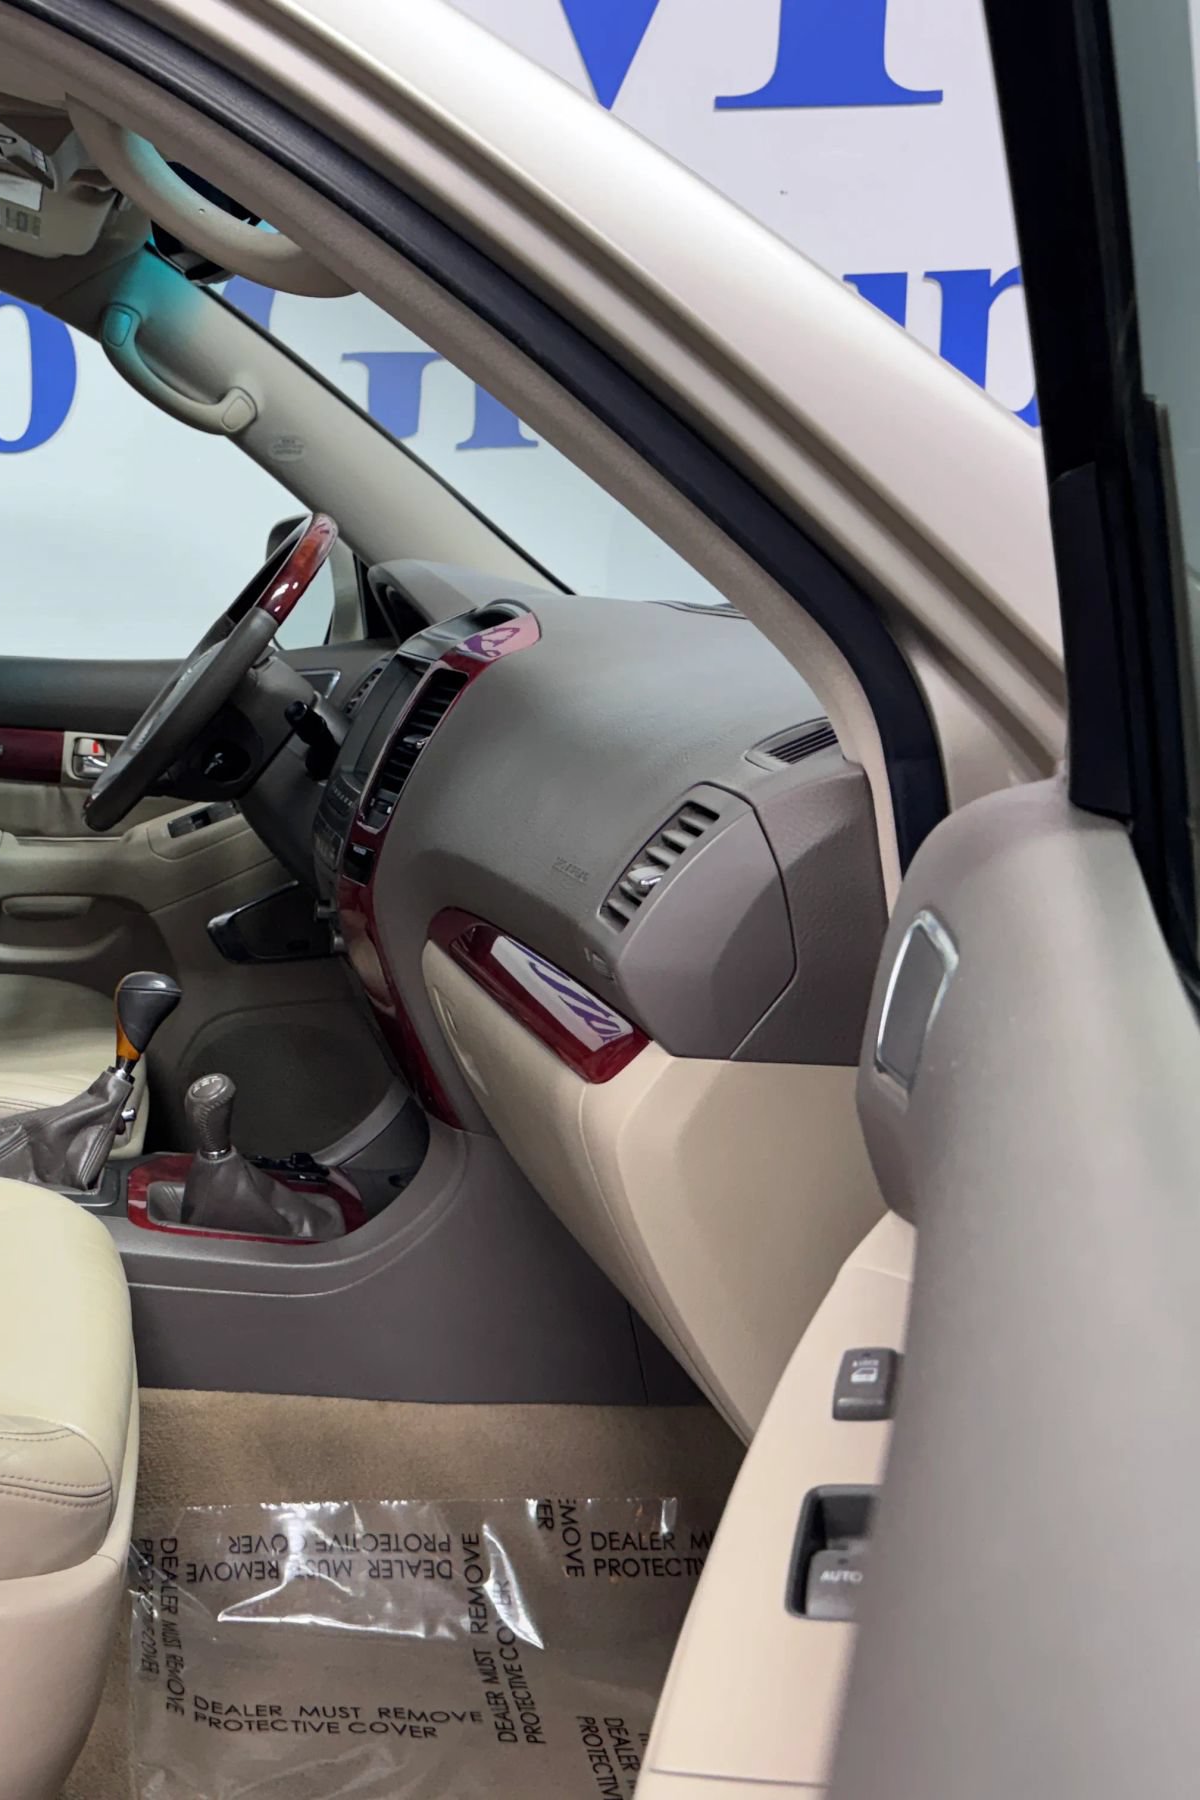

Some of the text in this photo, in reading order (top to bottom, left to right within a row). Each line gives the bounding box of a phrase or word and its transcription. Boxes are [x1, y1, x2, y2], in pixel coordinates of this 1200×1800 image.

[590, 1530, 676, 1551] DEALER
[186, 1560, 279, 1584] REMOVE
[368, 1558, 453, 1579] DEALER
[820, 1570, 863, 1583] AUTO
[160, 1537, 185, 1717] DEALER MUST REMOVE
[462, 1533, 518, 1744] DEALER MUST REMOVE
[193, 1695, 484, 1724] DEALER MUST REMOVE
[503, 1663, 547, 1744] PROTECTIVE
[193, 1711, 438, 1739] PROTECTIVE COVER
[576, 1715, 626, 1800] PROTECTIV
[603, 1717, 641, 1772] DEALER
